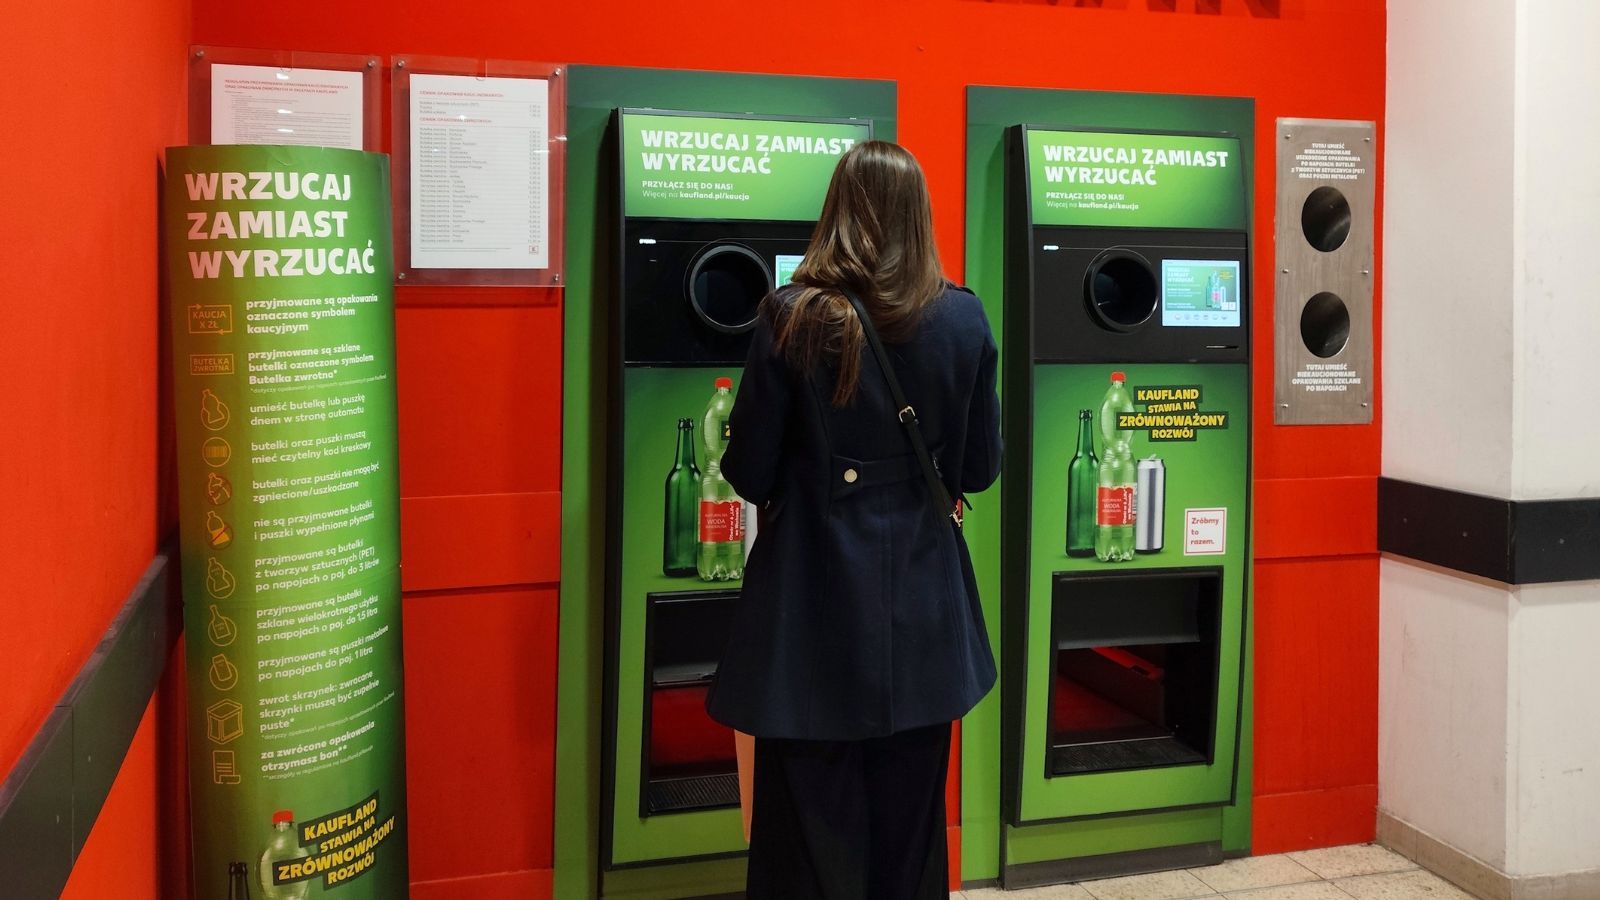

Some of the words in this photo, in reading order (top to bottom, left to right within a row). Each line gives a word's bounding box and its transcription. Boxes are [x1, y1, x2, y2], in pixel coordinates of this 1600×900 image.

[640, 130, 748, 151] WRZUCAJ
[756, 135, 855, 155] ZAMIAST
[641, 152, 771, 174] WYRZUCAĆ
[1043, 145, 1137, 164] WRZUCAJ
[1142, 148, 1228, 168] ZAMIAST
[642, 180, 684, 190] PRZYŁĄCZ
[686, 182, 699, 190] SIĘ
[700, 182, 712, 190] DO
[1044, 164, 1158, 186] WYRZUCAĆ
[184, 172, 351, 201] WRZUCAJ
[642, 191, 667, 200] Więcej
[680, 191, 750, 201] kaufland.pl/kaucja
[1046, 192, 1082, 201] PRZYŁĄCZ
[1084, 193, 1095, 201] SIĘ
[1046, 201, 1068, 209] Więcej
[1078, 202, 1139, 210] kaufland.pl/kaucja
[187, 210, 348, 240] ZAMIAST
[187, 239, 375, 279] WYRZUCAĆ
[246, 297, 321, 310] przyjmowane
[325, 297, 335, 307] są
[337, 294, 378, 306] opakowania
[193, 310, 226, 319] KAUCJA
[247, 312, 308, 321] oznaczone
[311, 307, 355, 319] symbolem
[247, 323, 309, 335] kaucyjnym
[194, 358, 229, 366] BUTELKA
[248, 348, 319, 361] przyjmowane
[321, 347, 332, 356] są
[333, 344, 360, 354] szklane
[249, 362, 287, 372] butelki
[290, 359, 340, 370] oznaczone
[342, 354, 374, 365] symbolem
[194, 364, 229, 372] ZWROTNA
[249, 374, 291, 384] Butelka
[250, 404, 288, 414] umieść
[290, 400, 326, 410] butelkę
[328, 398, 340, 406] lub
[342, 394, 365, 405] puszkę
[1138, 389, 1199, 400] KAUFLAND
[251, 416, 280, 426] dnem
[295, 412, 326, 422] stronę
[328, 406, 364, 418] automatu
[1148, 403, 1182, 414] STAWIA
[1183, 402, 1196, 410] NA
[1120, 413, 1225, 427] ZRÓWNOWAŻONY
[252, 441, 288, 451] butelki
[291, 440, 314, 448] oraz
[316, 434, 342, 447] puszki
[344, 430, 366, 442] muszą
[1152, 428, 1194, 438] ROZWÓJ
[252, 454, 277, 464] mieć
[280, 448, 321, 462] czytelny
[324, 446, 339, 456] kod
[341, 442, 372, 455] kreskowy
[253, 480, 288, 490] butelki
[290, 477, 312, 486] oraz
[314, 472, 340, 484] puszki
[342, 468, 352, 477] nie
[354, 465, 370, 476] mogą
[370, 461, 380, 474] być
[253, 481, 358, 504] zgniecione/uszkodzone
[254, 519, 270, 527] nie
[272, 518, 284, 526] są
[288, 508, 348, 525] przyjmowane
[350, 502, 373, 512] butelki
[1191, 517, 1219, 526] Zróbmy
[260, 528, 294, 541] puszki
[296, 520, 348, 536] wypełnione
[349, 511, 375, 526] płynami
[255, 551, 323, 566] przyjmowane
[326, 548, 336, 556] są
[338, 539, 364, 552] butelki
[264, 566, 308, 578] tworzyw
[311, 555, 358, 570] sztucznych
[358, 546, 375, 560] (PET)
[256, 584, 270, 592] po
[272, 575, 320, 590] napojach
[330, 570, 346, 581] poj.
[348, 566, 358, 575] do
[364, 558, 380, 570] litrów
[256, 602, 323, 618] przyjmowane
[325, 598, 336, 606] są
[337, 588, 362, 603] butelki
[257, 618, 294, 629] szklane
[298, 604, 358, 624] wielokrotnego
[358, 595, 378, 609] użytku
[257, 635, 270, 644] po
[274, 625, 320, 640] napojach
[330, 621, 345, 632] poj.
[346, 616, 356, 625] do
[357, 611, 366, 622] 1,5
[366, 607, 378, 618] litra
[258, 650, 326, 668] przyjmowane
[328, 648, 340, 656] są
[341, 638, 364, 653] puszki
[365, 625, 388, 641] metalowe
[258, 672, 272, 682] po
[276, 663, 322, 680] napojach
[326, 660, 336, 668] do
[339, 656, 353, 668] poj.
[360, 646, 373, 658] litra
[259, 695, 290, 706] zwrot
[292, 686, 337, 700] skrzynek:
[340, 672, 373, 690] zwracane
[260, 704, 303, 718] skrzynki
[305, 698, 336, 710] muszą
[338, 692, 352, 704] być
[354, 679, 380, 697] zupełnie
[261, 750, 274, 760] za
[276, 741, 326, 757] zwrócone
[329, 720, 374, 745] opakowania
[262, 756, 317, 773] otrzymasz
[304, 798, 376, 841] KAUFLAND
[320, 828, 362, 853] STAWIA
[364, 816, 376, 832] NA
[278, 816, 395, 881] ZRÓWNOWAŻONY
[327, 852, 375, 884] ROZWÓJ
